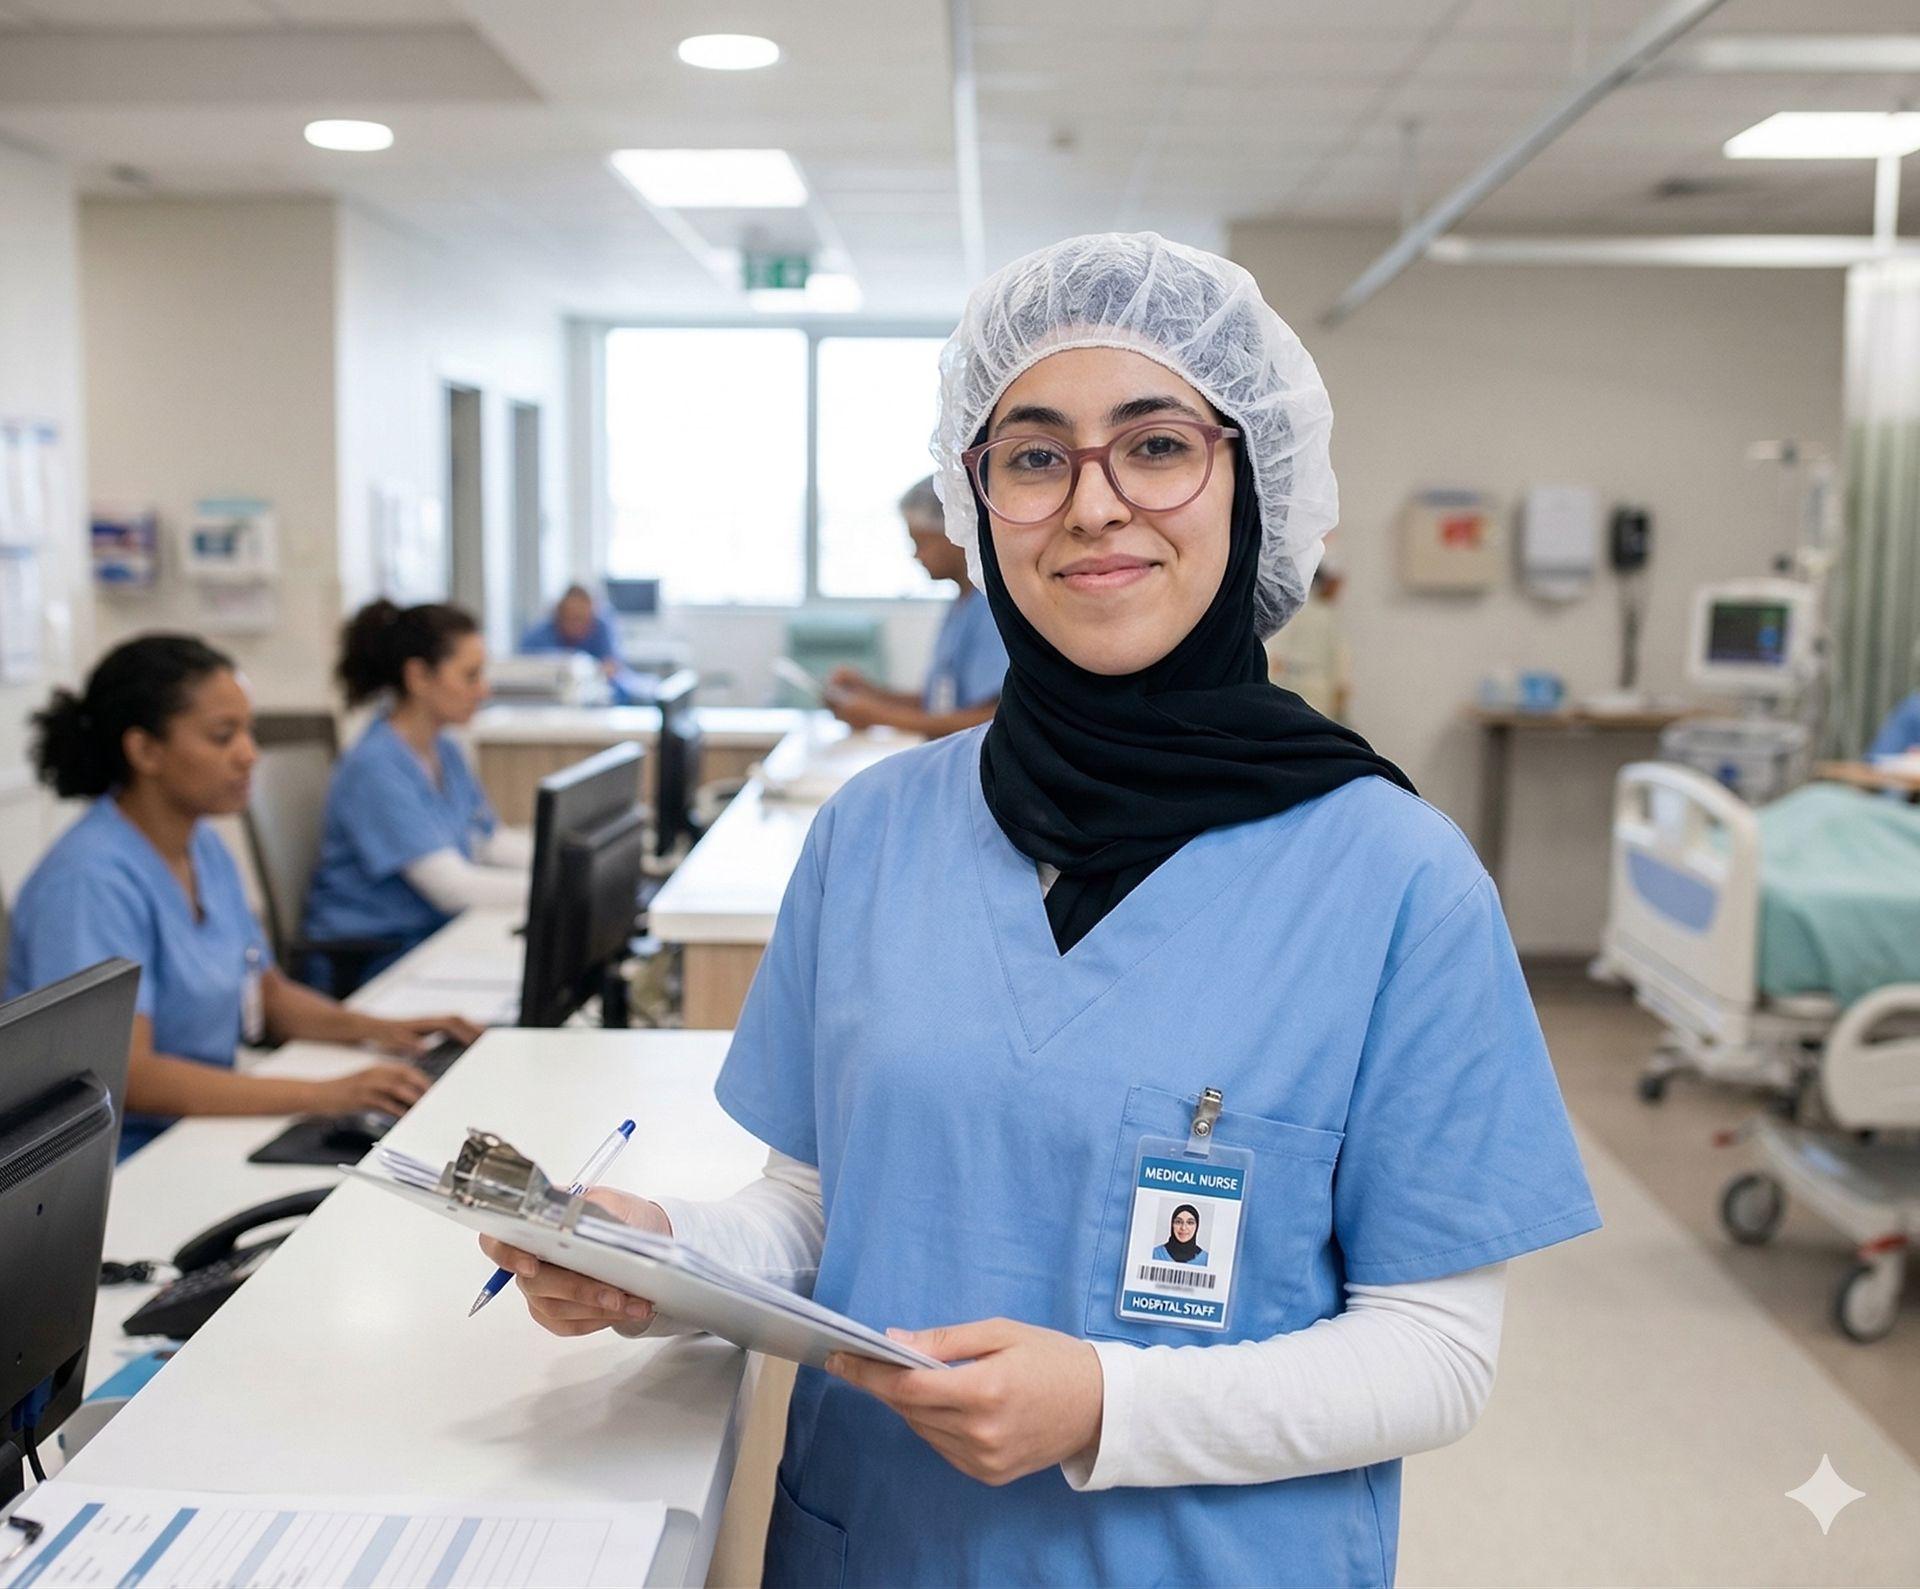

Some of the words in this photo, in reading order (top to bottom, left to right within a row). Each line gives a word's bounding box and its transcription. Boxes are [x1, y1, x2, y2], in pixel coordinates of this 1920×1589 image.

[1145, 1167, 1197, 1185] MEDICAL
[1199, 1174, 1238, 1190] NURSE
[1183, 1303, 1215, 1317] STAFF
